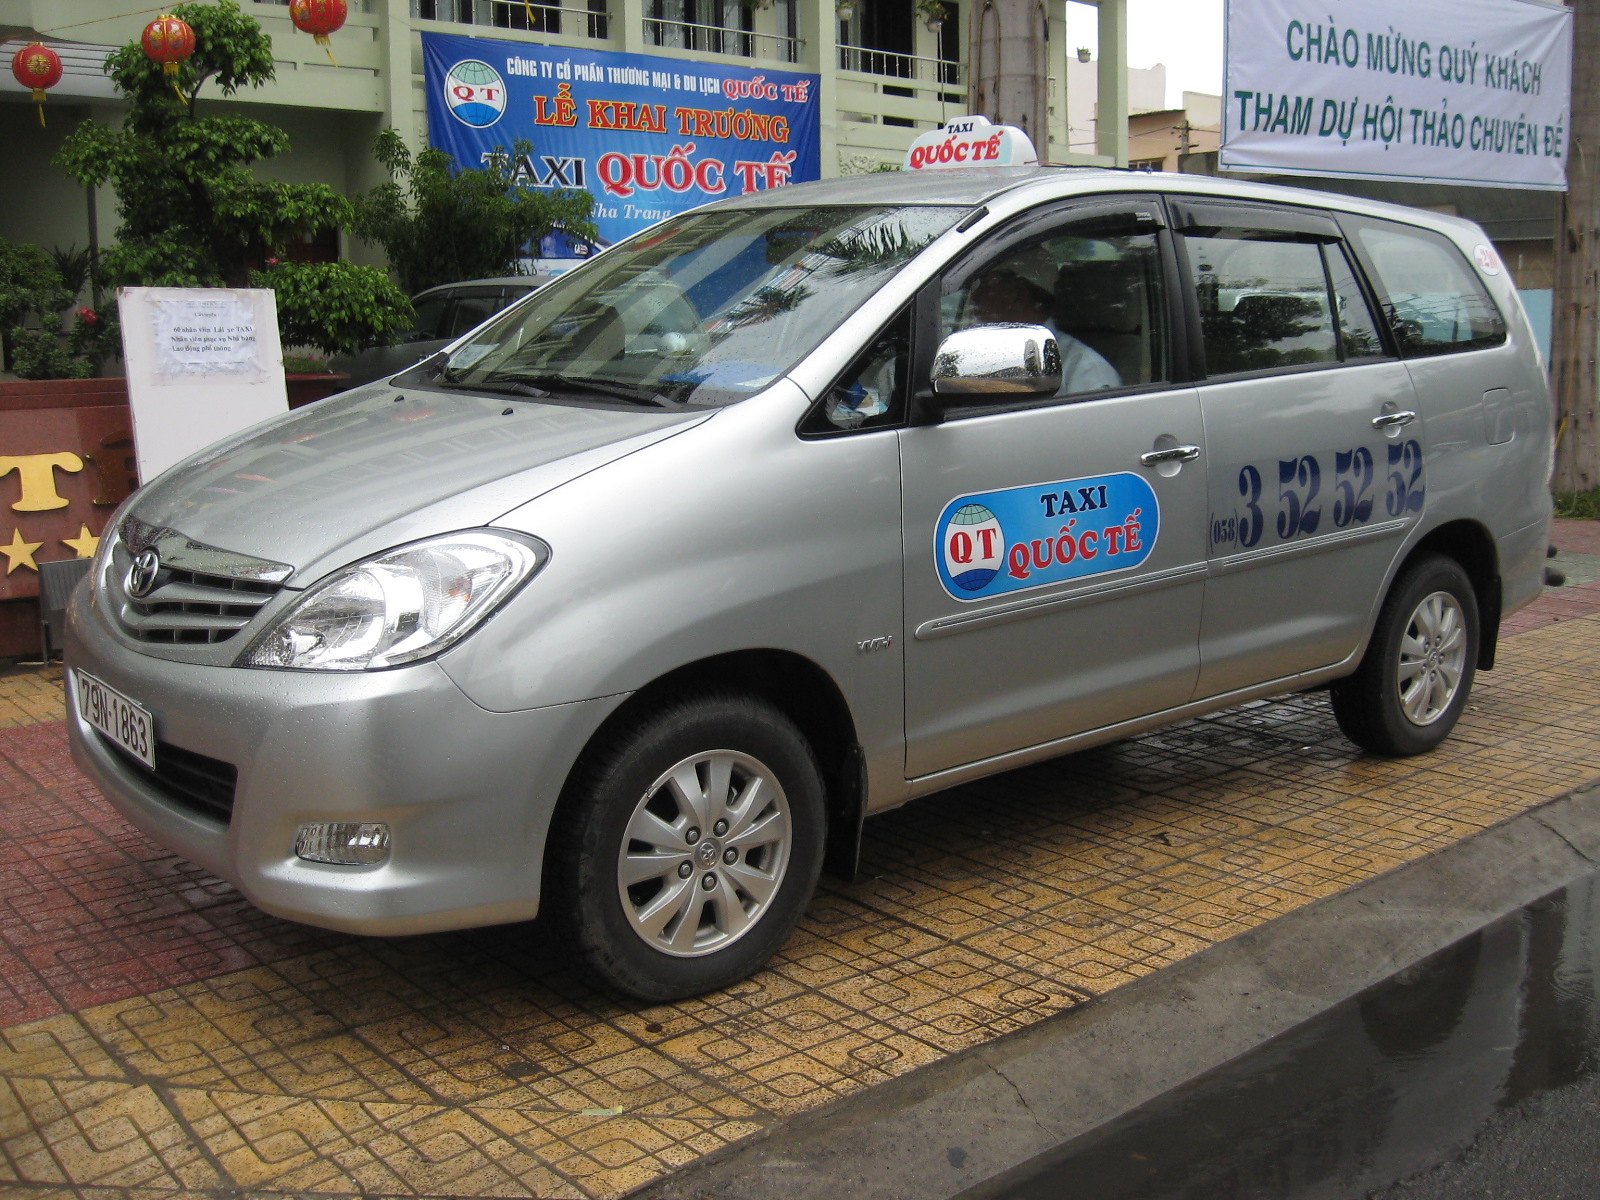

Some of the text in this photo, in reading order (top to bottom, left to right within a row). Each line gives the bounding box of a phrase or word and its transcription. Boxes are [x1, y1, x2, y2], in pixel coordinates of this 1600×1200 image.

[1287, 15, 1543, 96] CHÀO MỪNG QUÝ KHÁCH
[453, 86, 500, 101] QT
[506, 56, 538, 77] CÔNG
[540, 61, 553, 79] TY
[556, 58, 572, 81] CỔ
[606, 66, 650, 88] THƯƠNG
[652, 71, 672, 92] MẠI
[674, 74, 682, 90] &
[683, 76, 698, 92] DU
[699, 77, 721, 97] LỊCH
[722, 76, 779, 101] QUỐC
[781, 80, 811, 103] TẾ
[533, 83, 790, 143] LỄ KHAI TRƯƠNG
[947, 122, 974, 134] TAXI
[1234, 90, 1313, 136] THAM
[1319, 96, 1358, 147] DỰ
[1363, 95, 1403, 151] HỘI
[1410, 98, 1465, 150] THẢO
[1470, 113, 1538, 156] CHUYÊN
[481, 142, 797, 198] TAXI QUỐC TẾ
[909, 131, 1004, 170] QUỐC TẾ
[623, 204, 671, 221] Trang
[1040, 485, 1109, 518] TAXI
[1209, 508, 1239, 554] (058)
[1277, 455, 1322, 539] 52
[1333, 446, 1375, 527] 52
[1386, 439, 1425, 516] 52
[949, 528, 998, 563] QT
[1008, 508, 1143, 580] QUỐC TẾ
